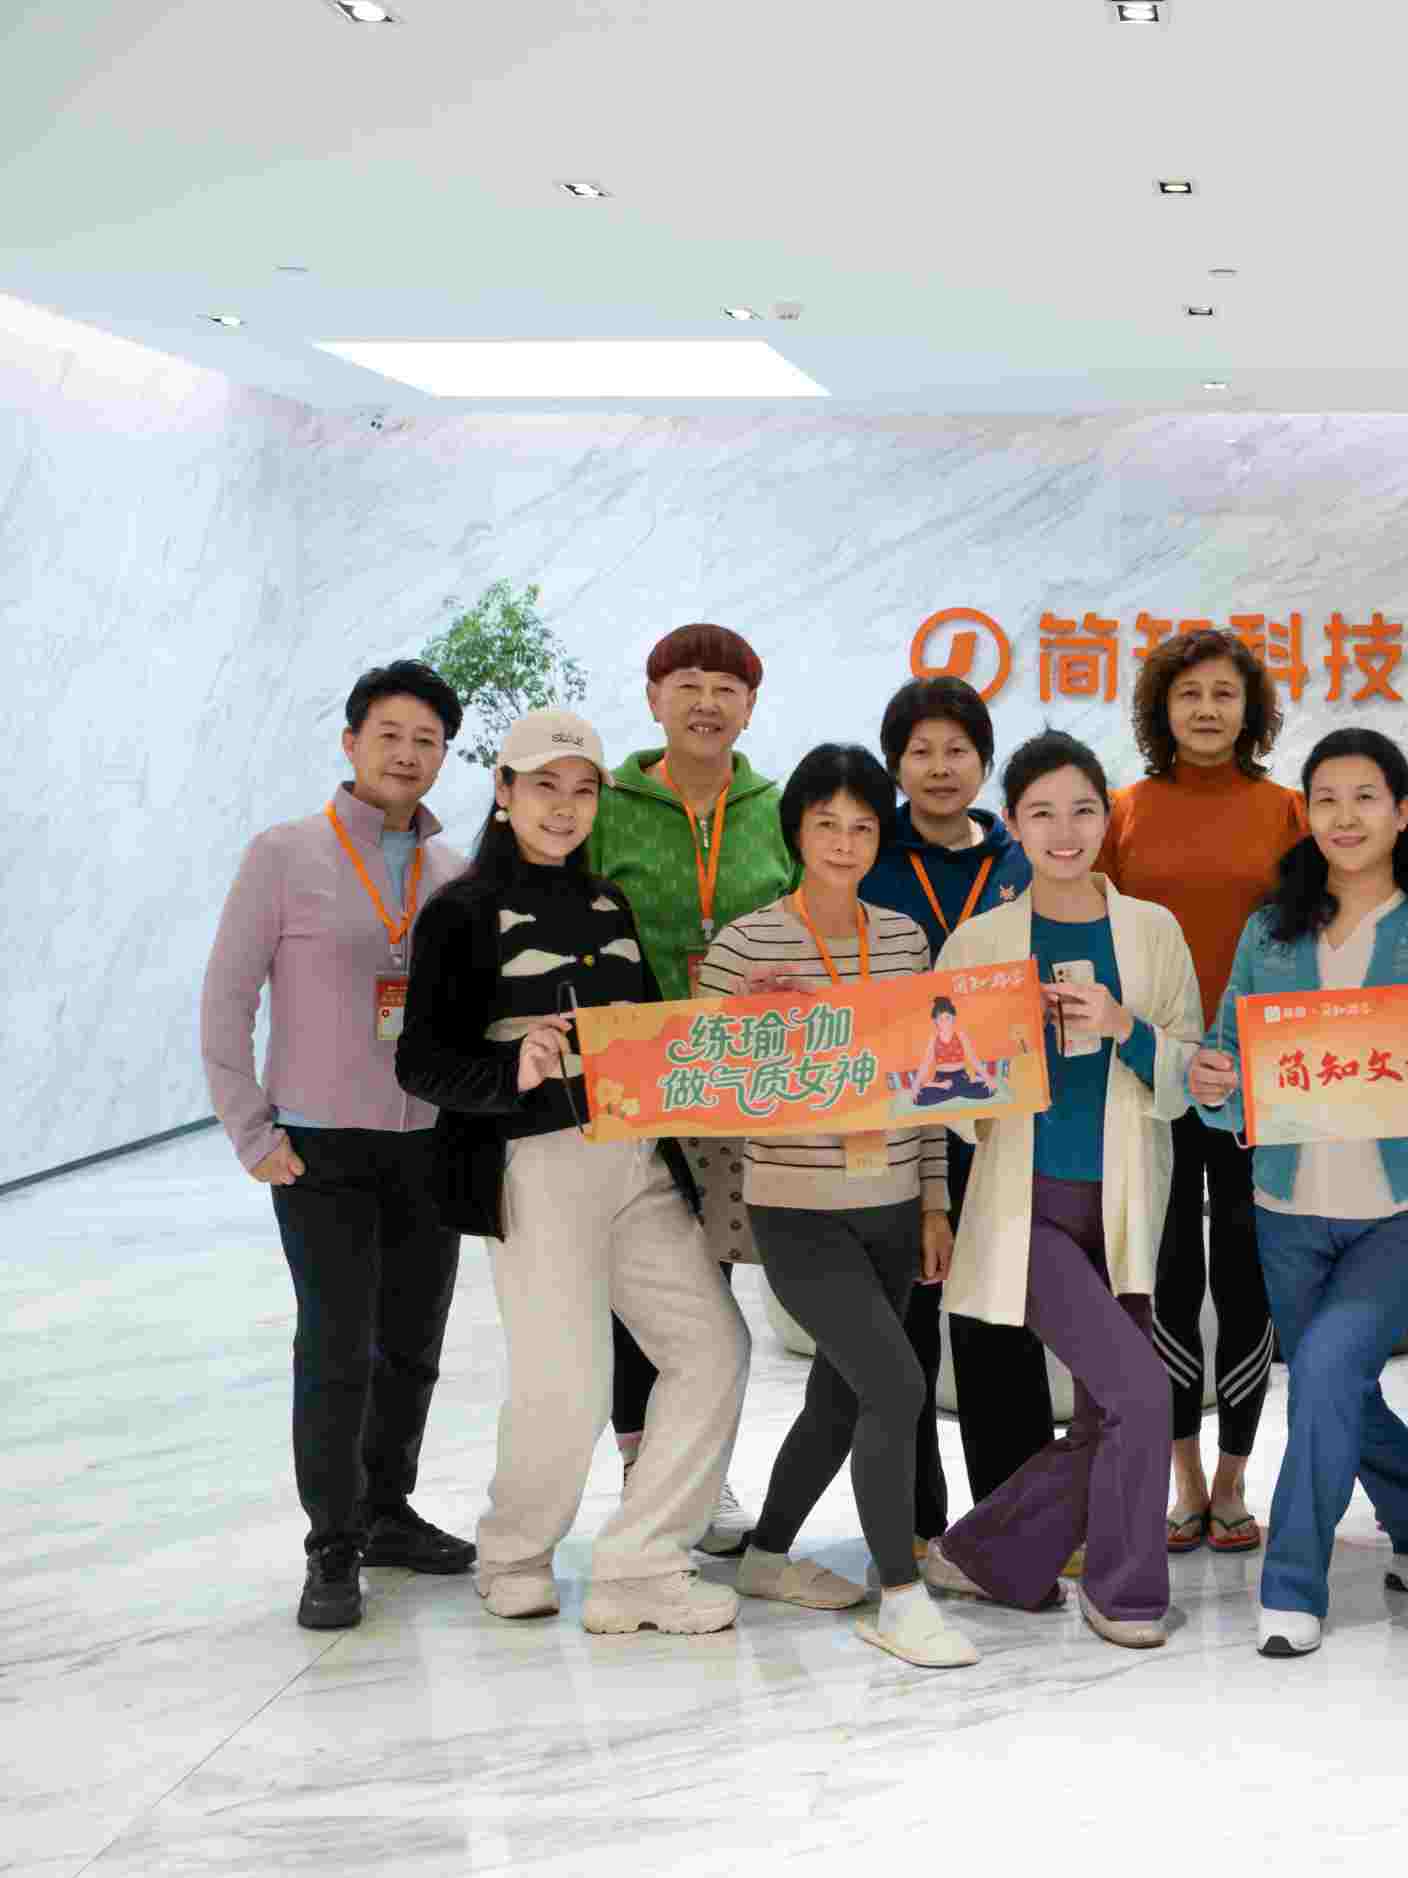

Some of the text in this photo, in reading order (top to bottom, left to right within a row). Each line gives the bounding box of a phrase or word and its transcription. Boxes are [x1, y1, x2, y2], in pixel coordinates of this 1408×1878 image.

[667, 1003, 853, 1063] 练瑜伽
[658, 1050, 878, 1116] 做气质女神
